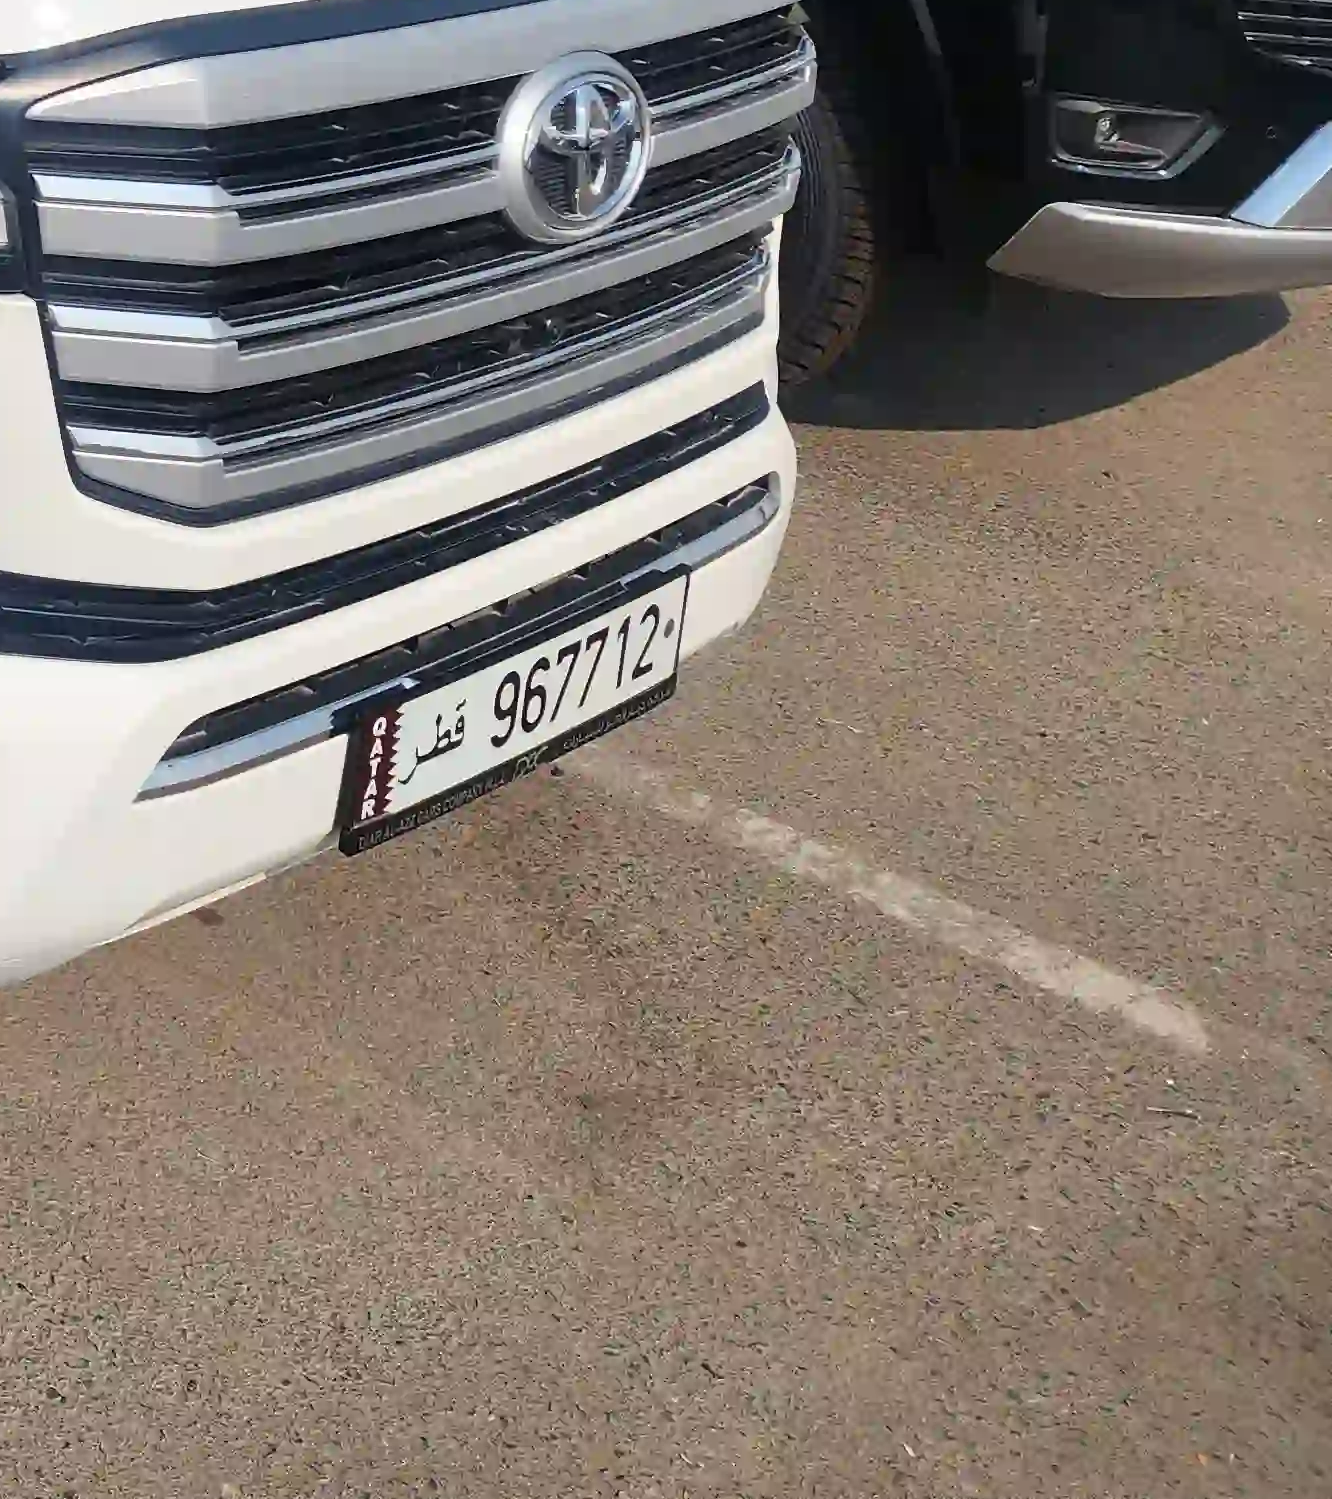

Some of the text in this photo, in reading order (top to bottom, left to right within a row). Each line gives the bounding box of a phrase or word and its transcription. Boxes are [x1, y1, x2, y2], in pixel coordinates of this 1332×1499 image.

[490, 603, 660, 748] 967712
[361, 716, 387, 820] QATAR
[398, 699, 467, 785] قطر
